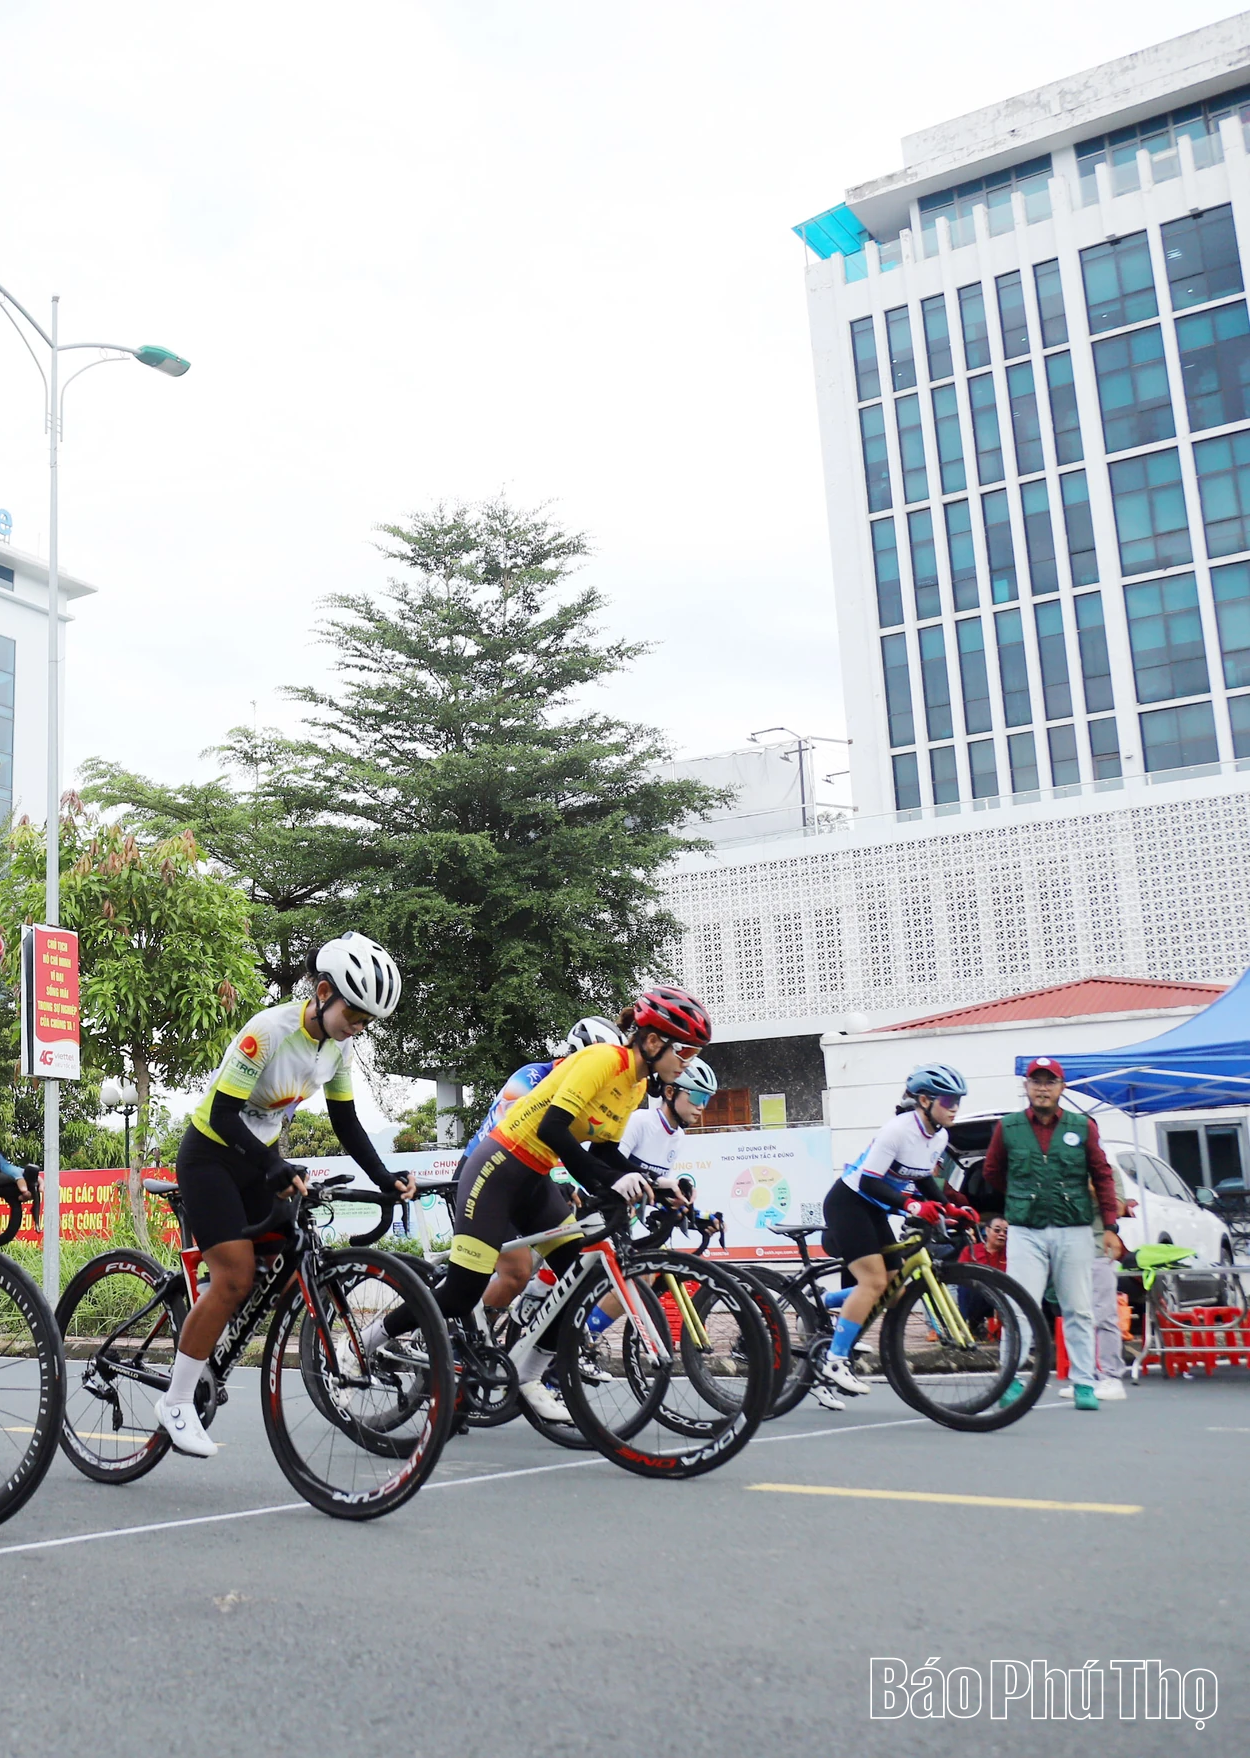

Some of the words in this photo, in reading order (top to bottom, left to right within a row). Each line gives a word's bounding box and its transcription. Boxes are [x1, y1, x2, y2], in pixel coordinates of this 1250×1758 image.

[59, 956, 72, 969] MINH
[37, 1000, 53, 1012] TRONG
[39, 1050, 54, 1066] 4G
[54, 1052, 75, 1062] viettel
[509, 1120, 520, 1131] HO
[520, 1109, 532, 1121] CHI
[530, 1098, 551, 1112] MINH
[491, 1150, 507, 1165] HO
[696, 1160, 712, 1169] TAY
[480, 1161, 495, 1178] CHI
[75, 1182, 94, 1204] CÁC
[469, 1175, 486, 1199] MINH
[464, 1198, 476, 1220] CITY
[61, 1210, 74, 1234] BỘ
[77, 1209, 103, 1230] CÔNG
[213, 1252, 285, 1366] PINARELLO
[269, 1310, 291, 1395] SPEED
[36, 1341, 49, 1416] LIMITED
[8, 1428, 43, 1492] EDITION
[100, 1447, 149, 1471] SPEED
[614, 1446, 678, 1470] ONE
